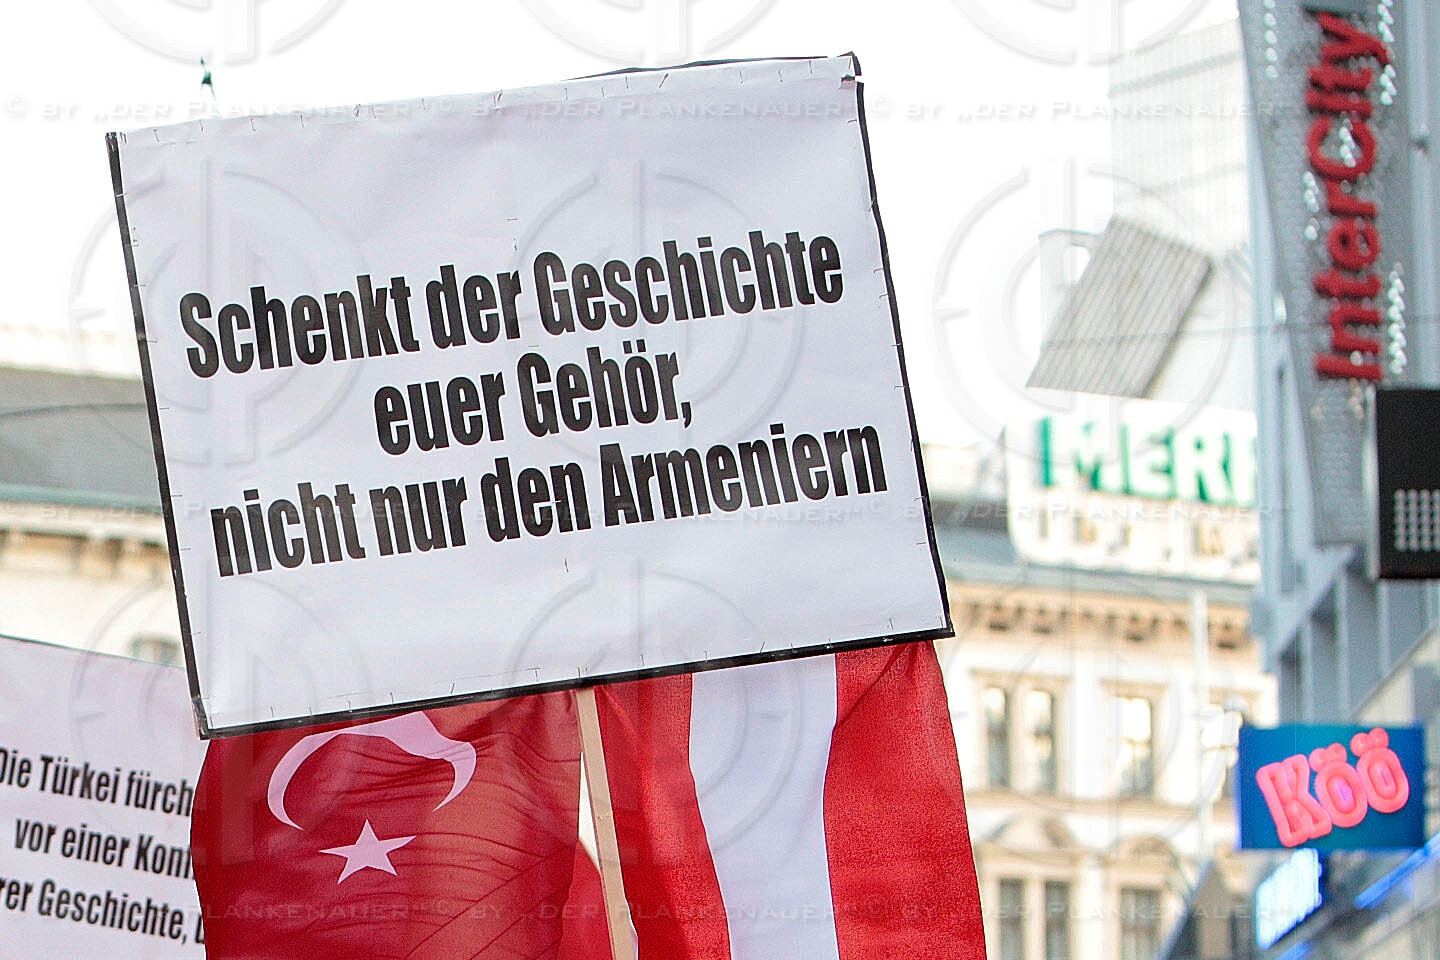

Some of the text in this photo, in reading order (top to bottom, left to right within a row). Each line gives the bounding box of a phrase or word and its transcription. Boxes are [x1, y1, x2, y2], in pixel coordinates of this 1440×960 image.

[1304, 11, 1390, 381] InterCity
[179, 230, 844, 378] Schenkt der Geschichte
[375, 339, 692, 454] euer Gehör,
[211, 423, 888, 577] nicht nur den Armeniern
[40, 753, 121, 804] Türkei
[14, 818, 57, 853] vor
[61, 824, 130, 868] einer
[37, 877, 188, 945] Geschichte,
